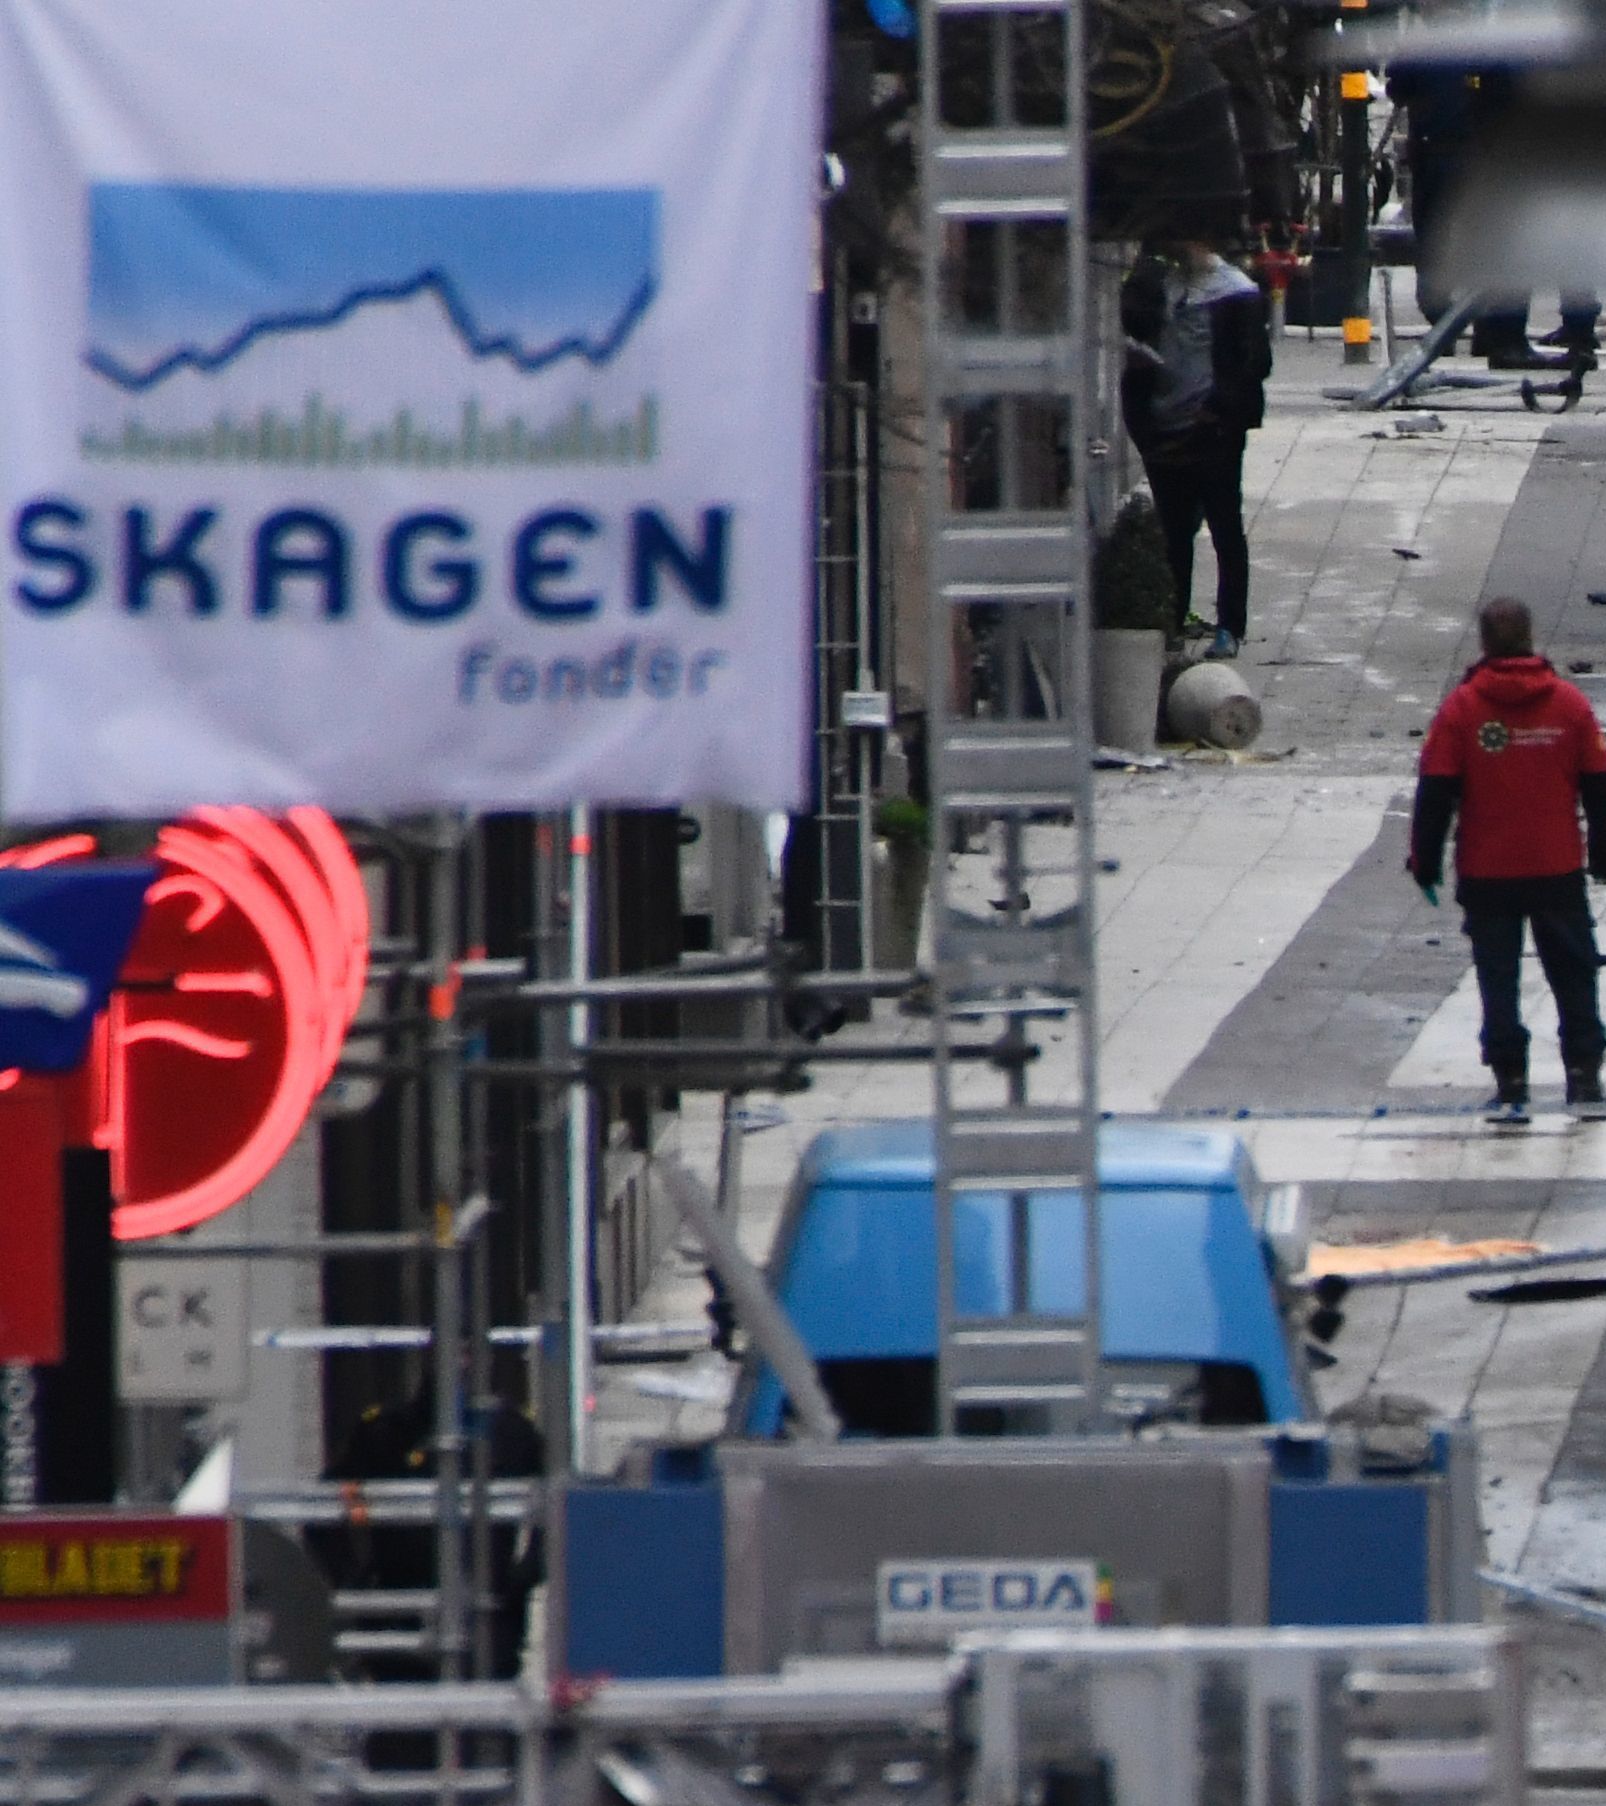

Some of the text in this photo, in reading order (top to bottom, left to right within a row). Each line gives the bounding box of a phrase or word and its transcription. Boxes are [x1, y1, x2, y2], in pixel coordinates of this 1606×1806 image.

[13, 500, 732, 624] SKAGEN
[457, 638, 728, 706] fonder
[889, 1572, 1084, 1611] GEDA
